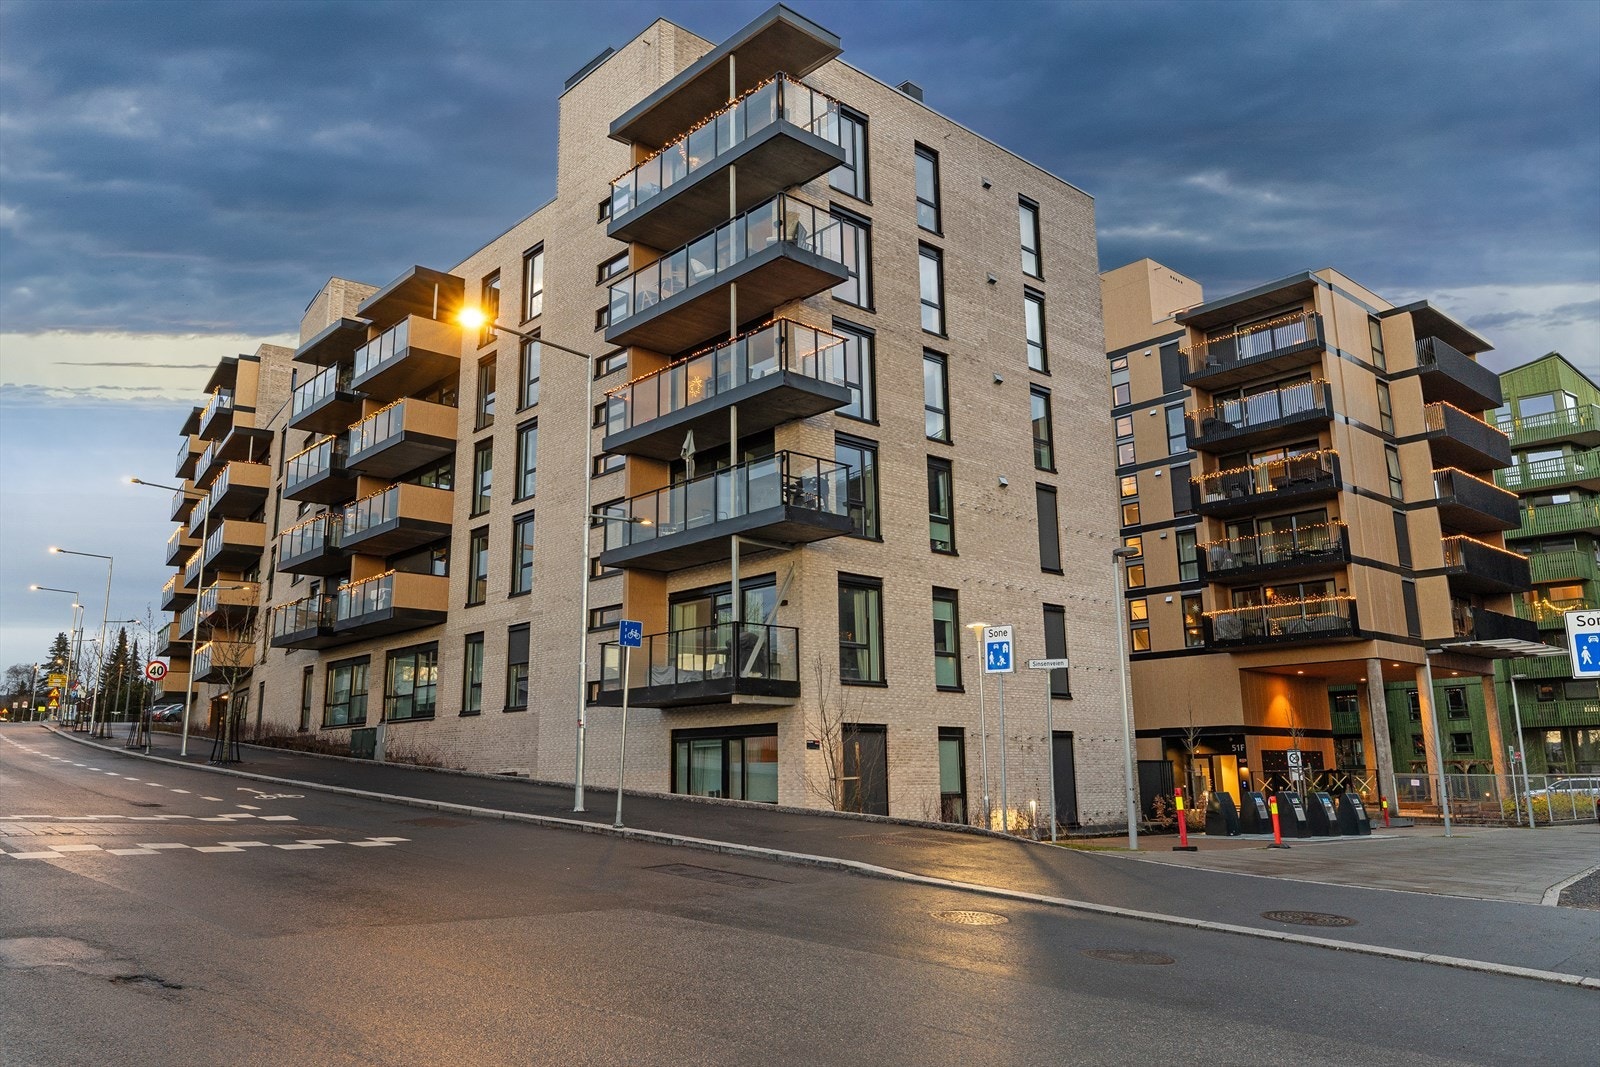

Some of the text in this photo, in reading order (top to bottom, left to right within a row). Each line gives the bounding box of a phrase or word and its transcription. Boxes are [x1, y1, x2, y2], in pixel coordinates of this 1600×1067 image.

[988, 629, 1008, 638] Sone
[150, 665, 164, 676] 40
[1231, 743, 1245, 752] 51F
